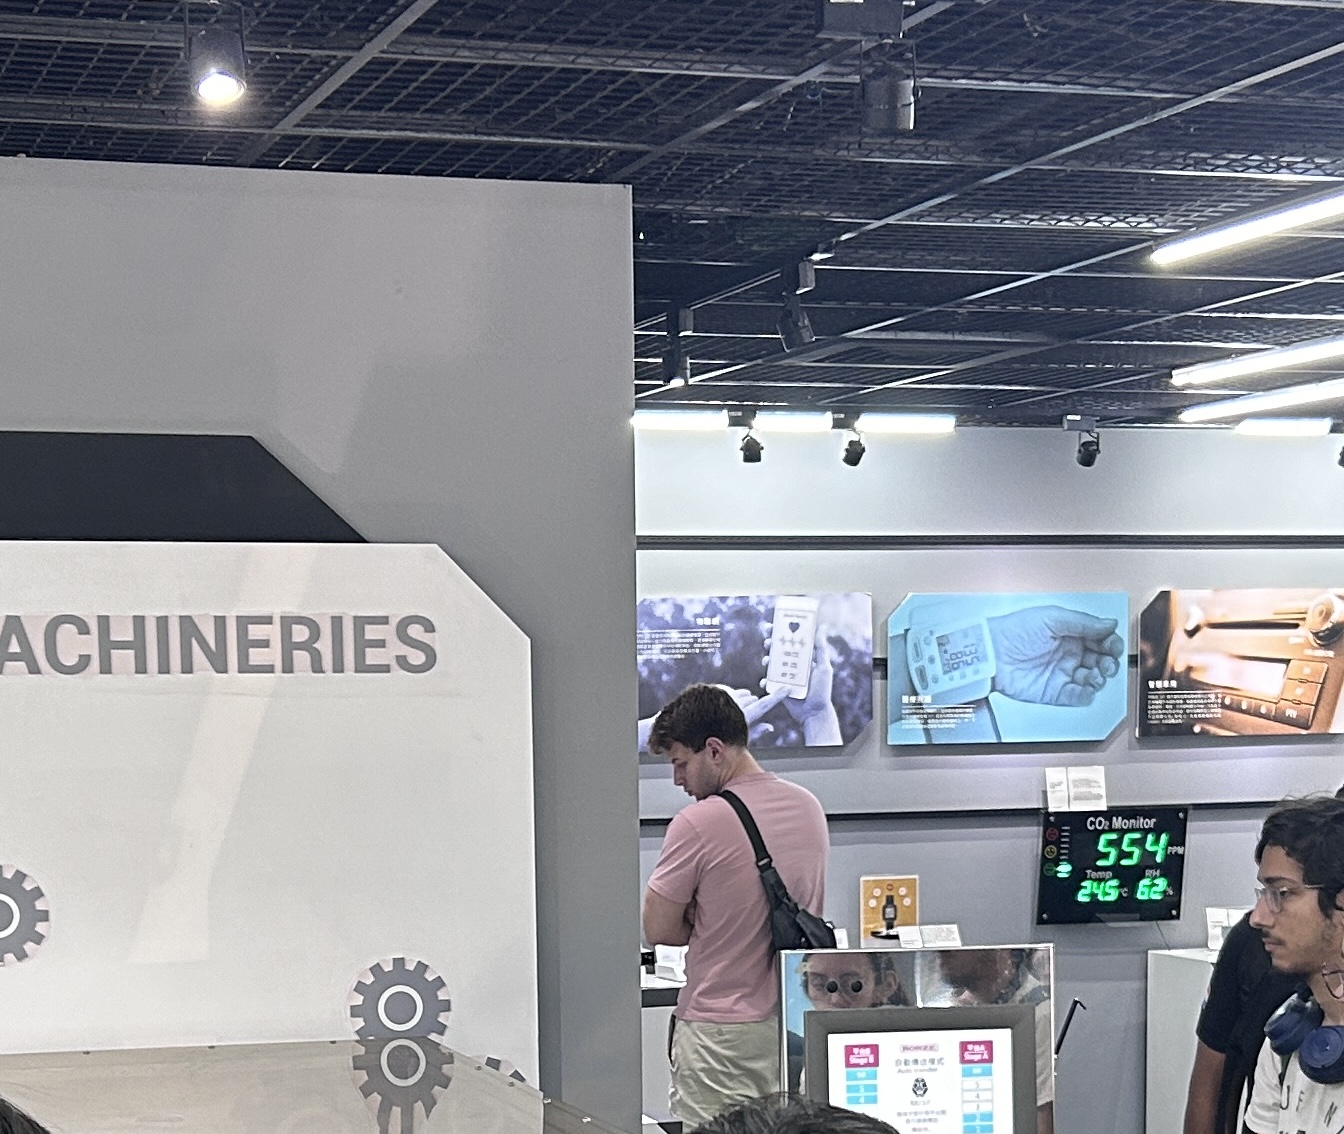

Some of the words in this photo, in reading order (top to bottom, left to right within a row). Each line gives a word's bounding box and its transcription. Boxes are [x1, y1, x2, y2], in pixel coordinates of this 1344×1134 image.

[1111, 816, 1157, 830] Monitor
[1095, 832, 1169, 867] 554
[1167, 846, 1185, 855] PPM
[1086, 870, 1113, 879] Temp
[1136, 877, 1168, 900] 62
